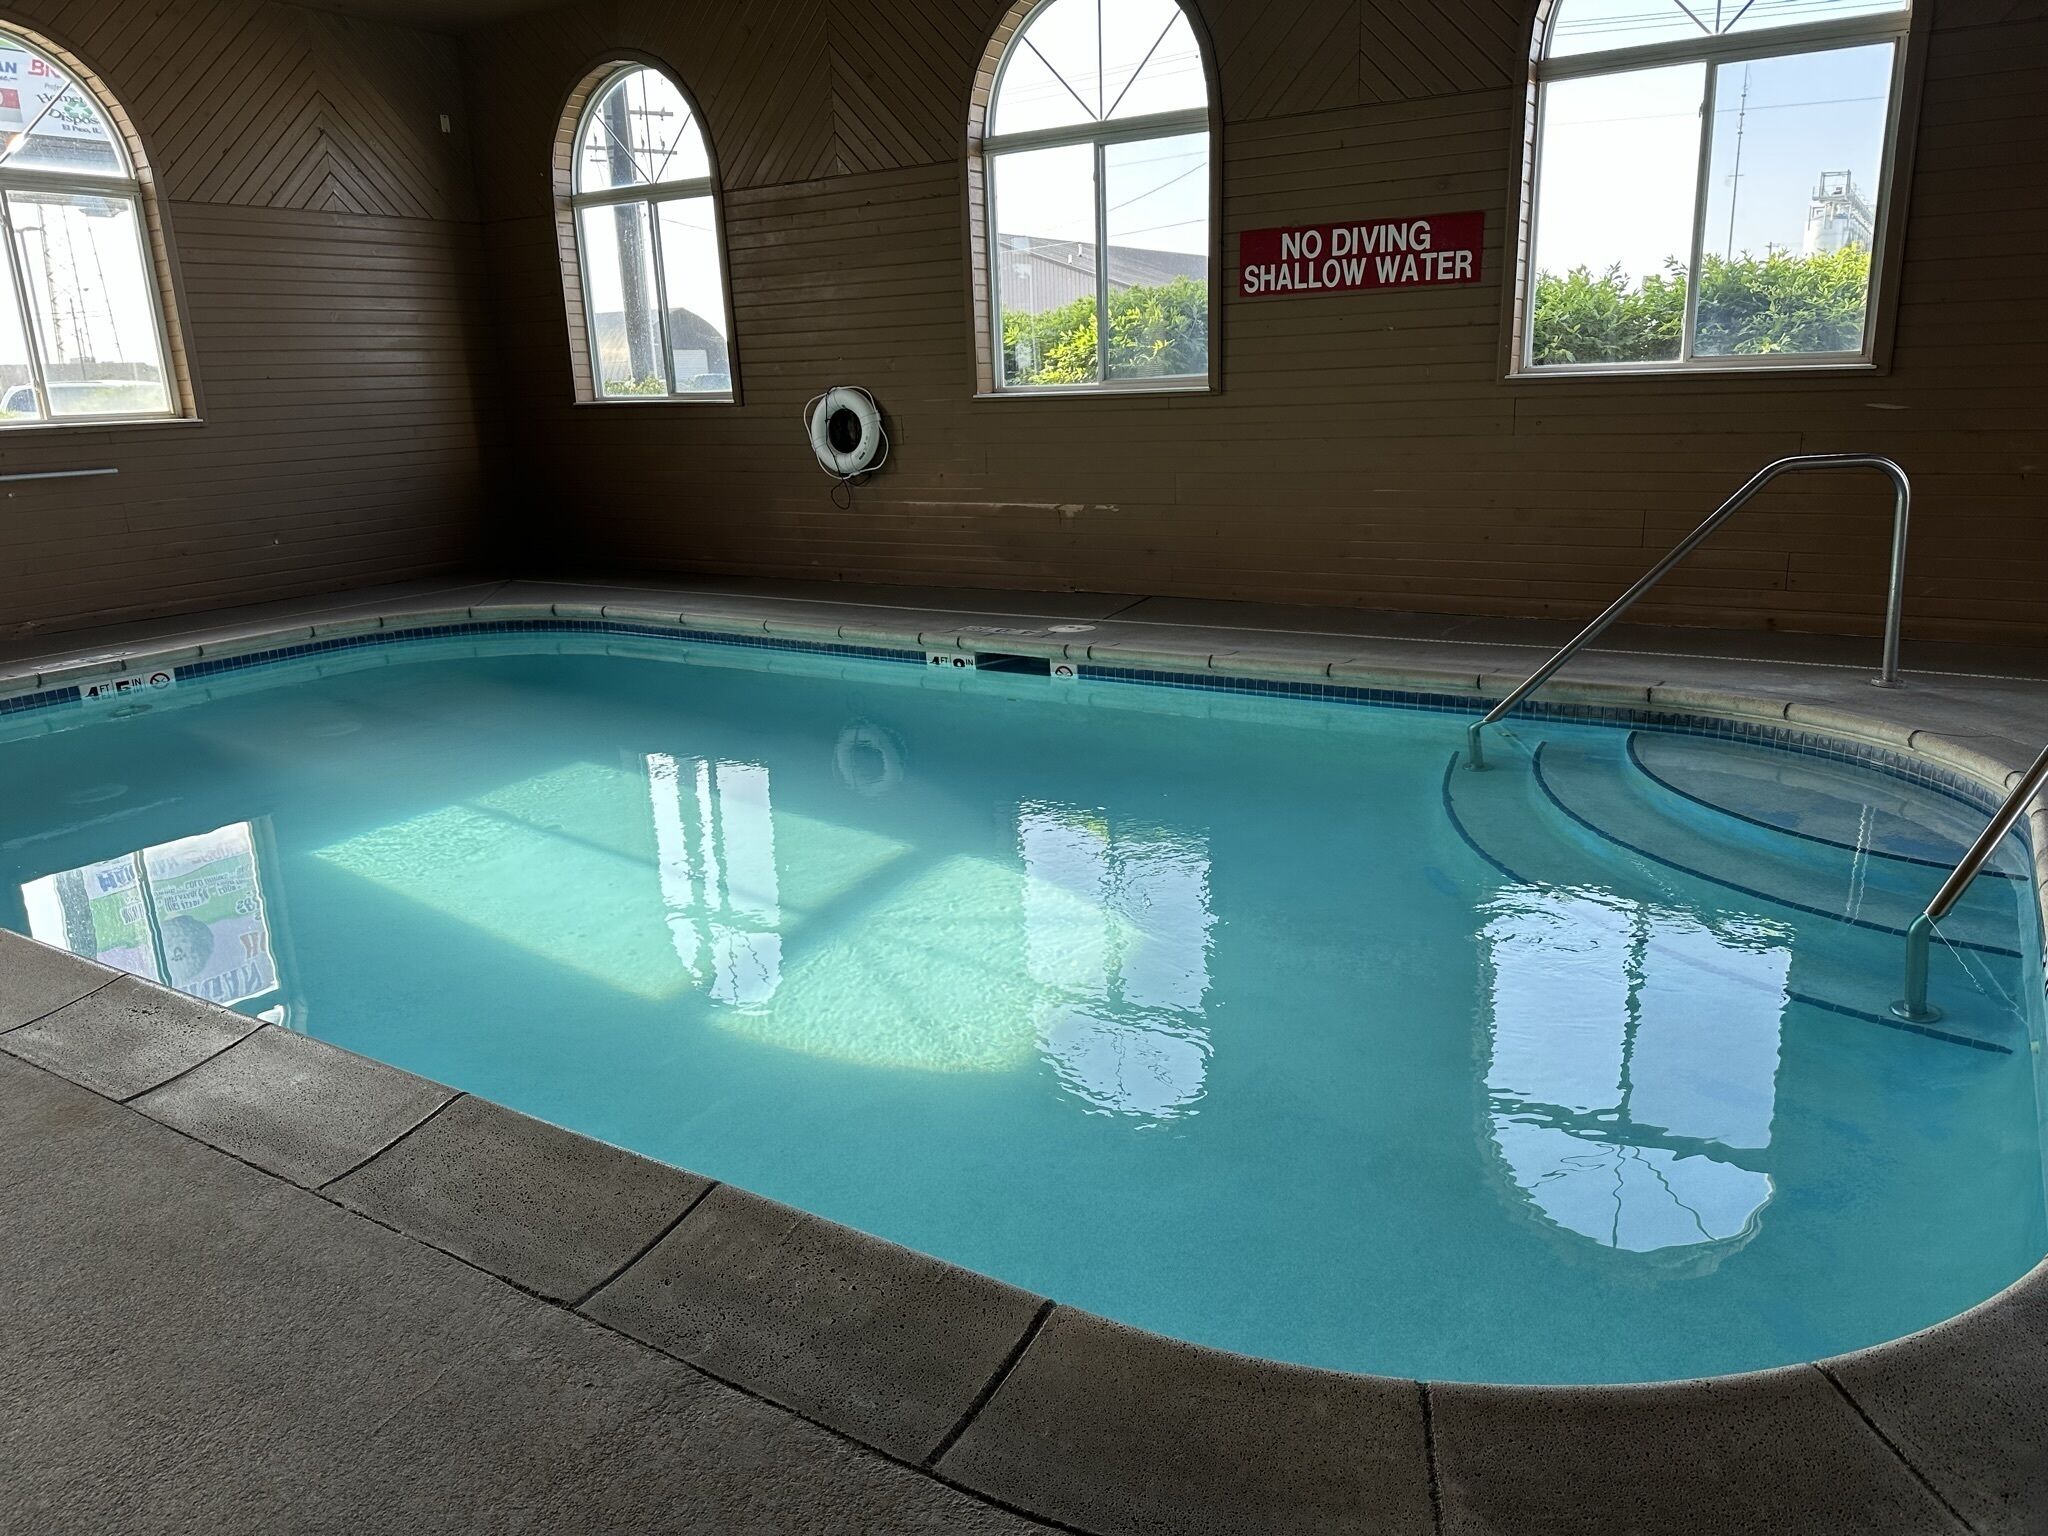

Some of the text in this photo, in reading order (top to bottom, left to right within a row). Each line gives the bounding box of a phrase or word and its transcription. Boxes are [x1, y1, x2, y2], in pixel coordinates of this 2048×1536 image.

[1281, 220, 1431, 260] NO DIVING
[1243, 250, 1473, 294] SHALLOW WATER
[85, 686, 99, 698] 4
